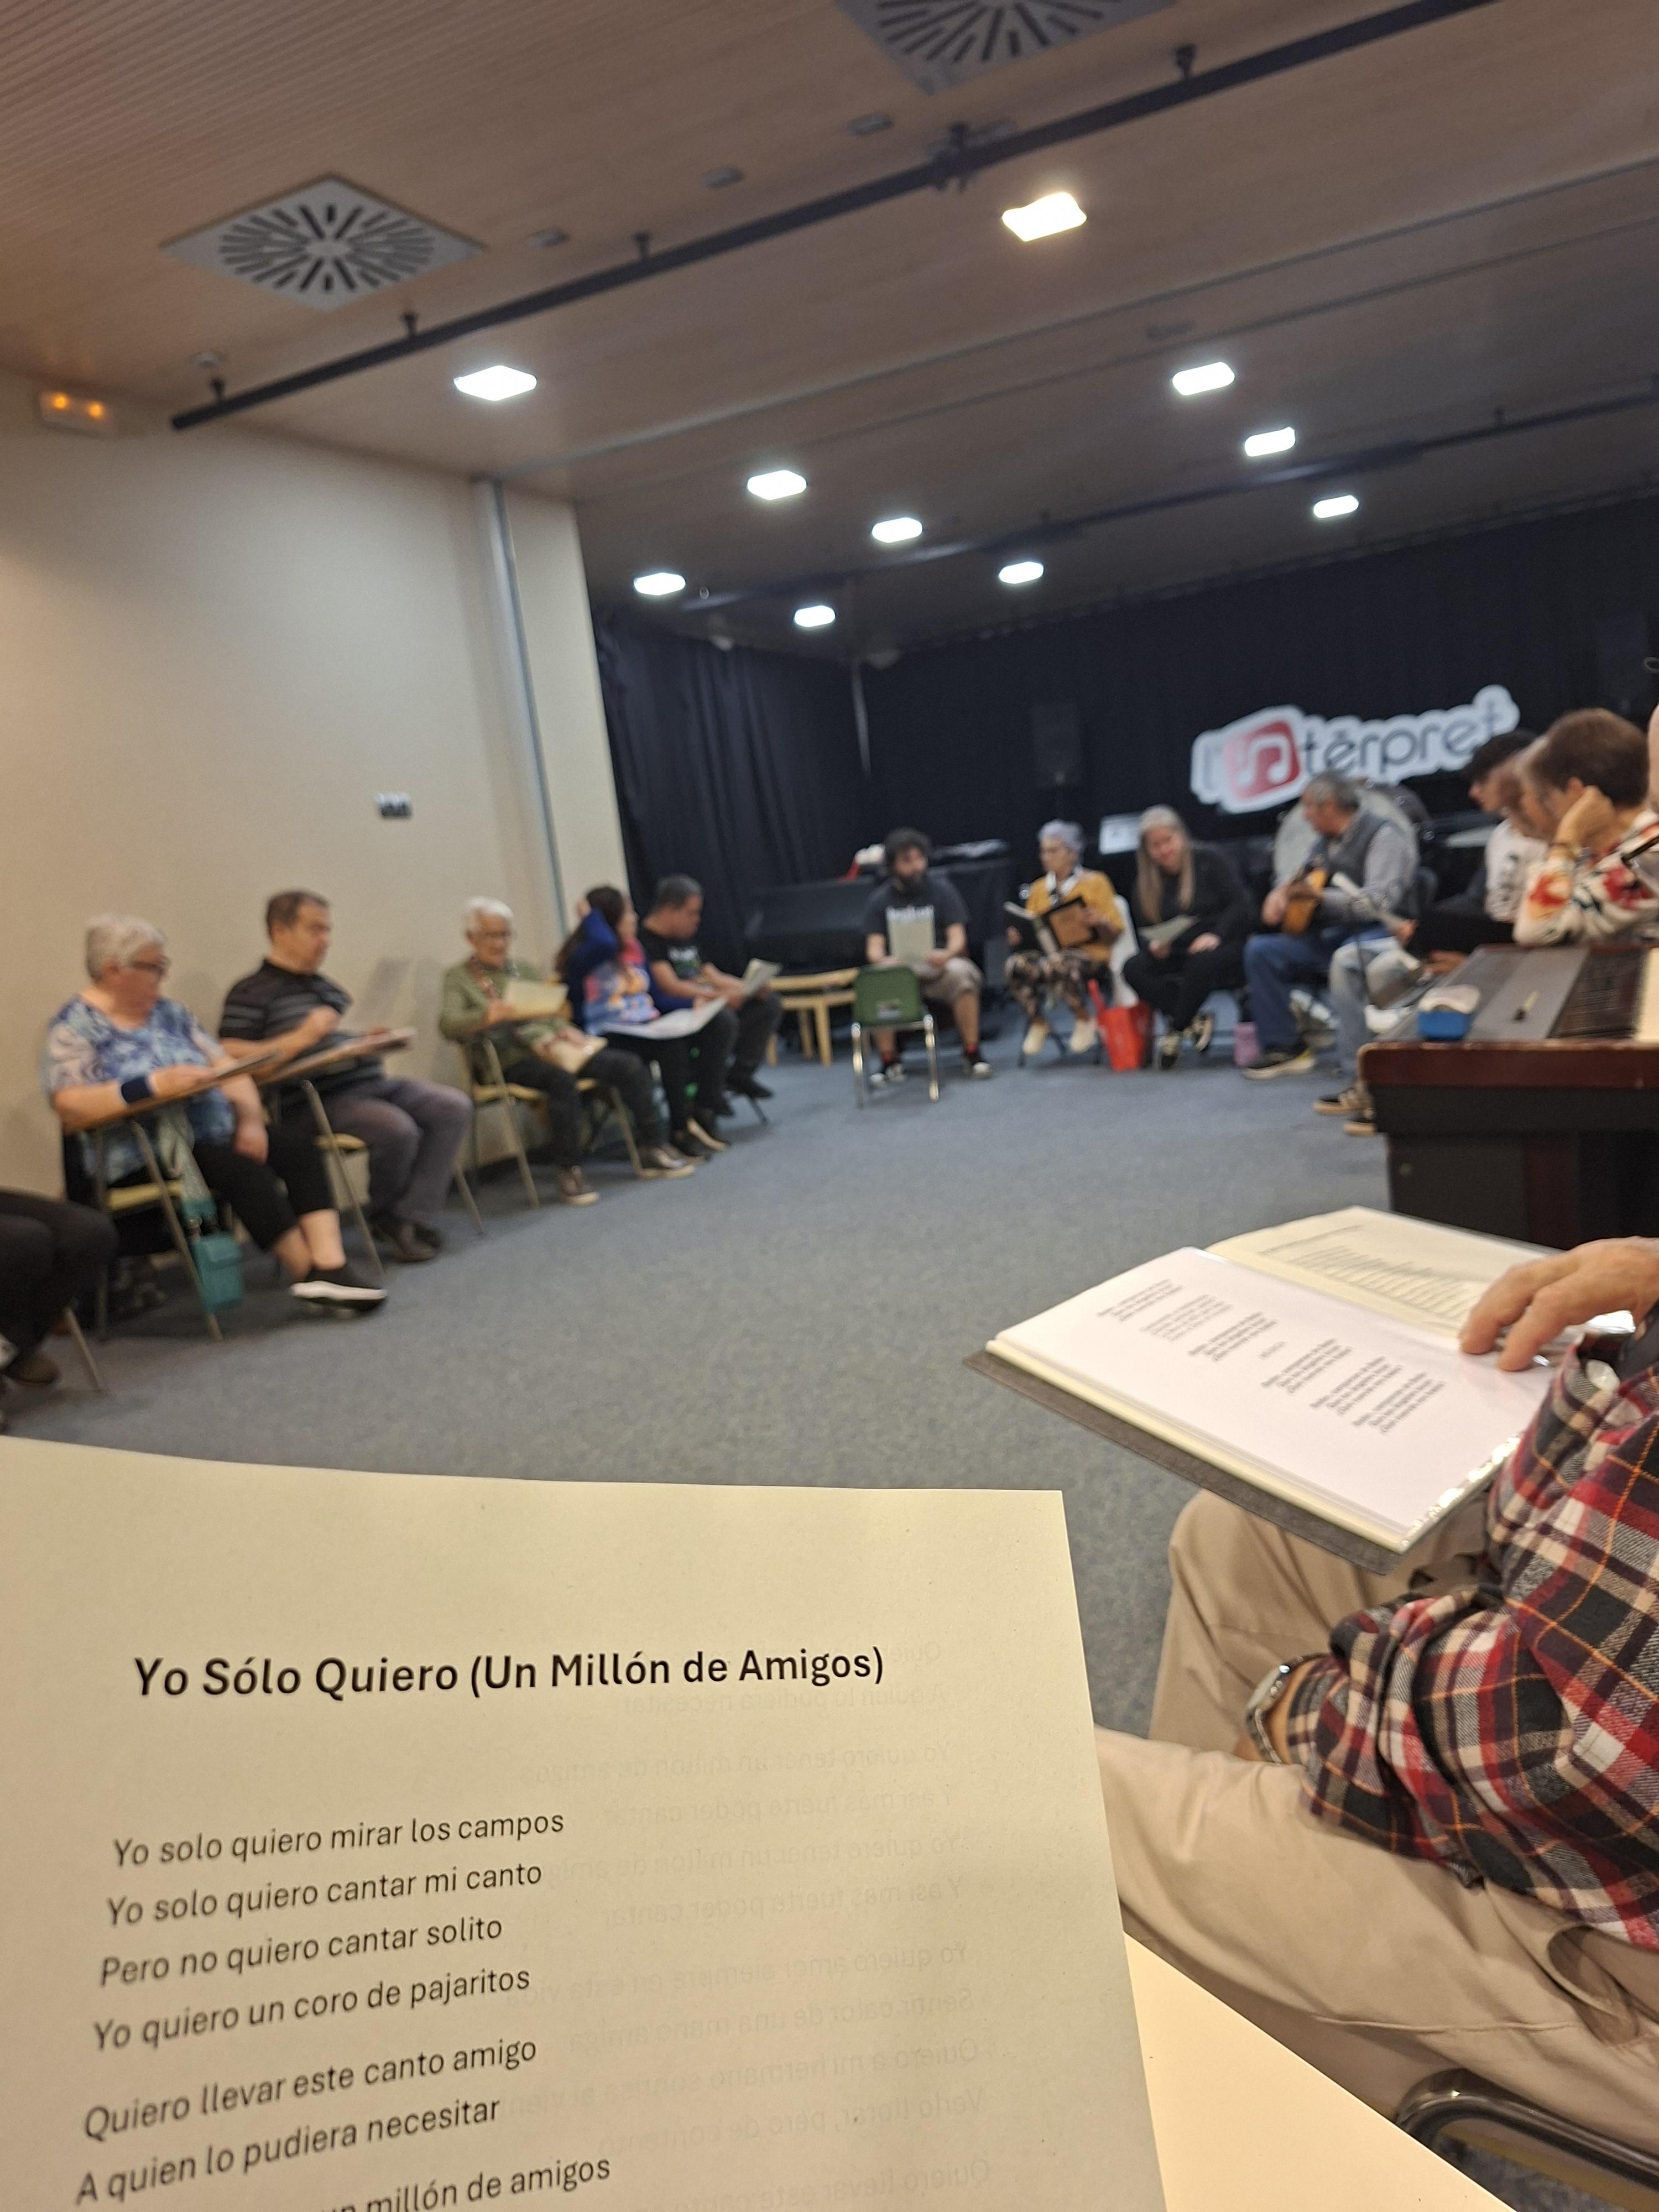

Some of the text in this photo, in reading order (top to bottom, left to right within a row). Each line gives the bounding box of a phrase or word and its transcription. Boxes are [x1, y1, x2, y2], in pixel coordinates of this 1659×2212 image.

[134, 1646, 883, 1702] Yo Sólo Quiero (Un Millón de Amigos)
[114, 1815, 564, 1867] Yo solo quiero mirar los campos
[108, 1864, 541, 1926] Yo solo quiero cantar mi canto
[101, 1916, 502, 1986] Pero no quiero cantar solito
[94, 1969, 529, 2050] Yo quiero un coro de pajaritos
[85, 2039, 536, 2142] Quiero llevar este canto amigo
[76, 2099, 500, 2205] A quien lo pudiera necesitar
[367, 2159, 609, 2212] millón de amigos
